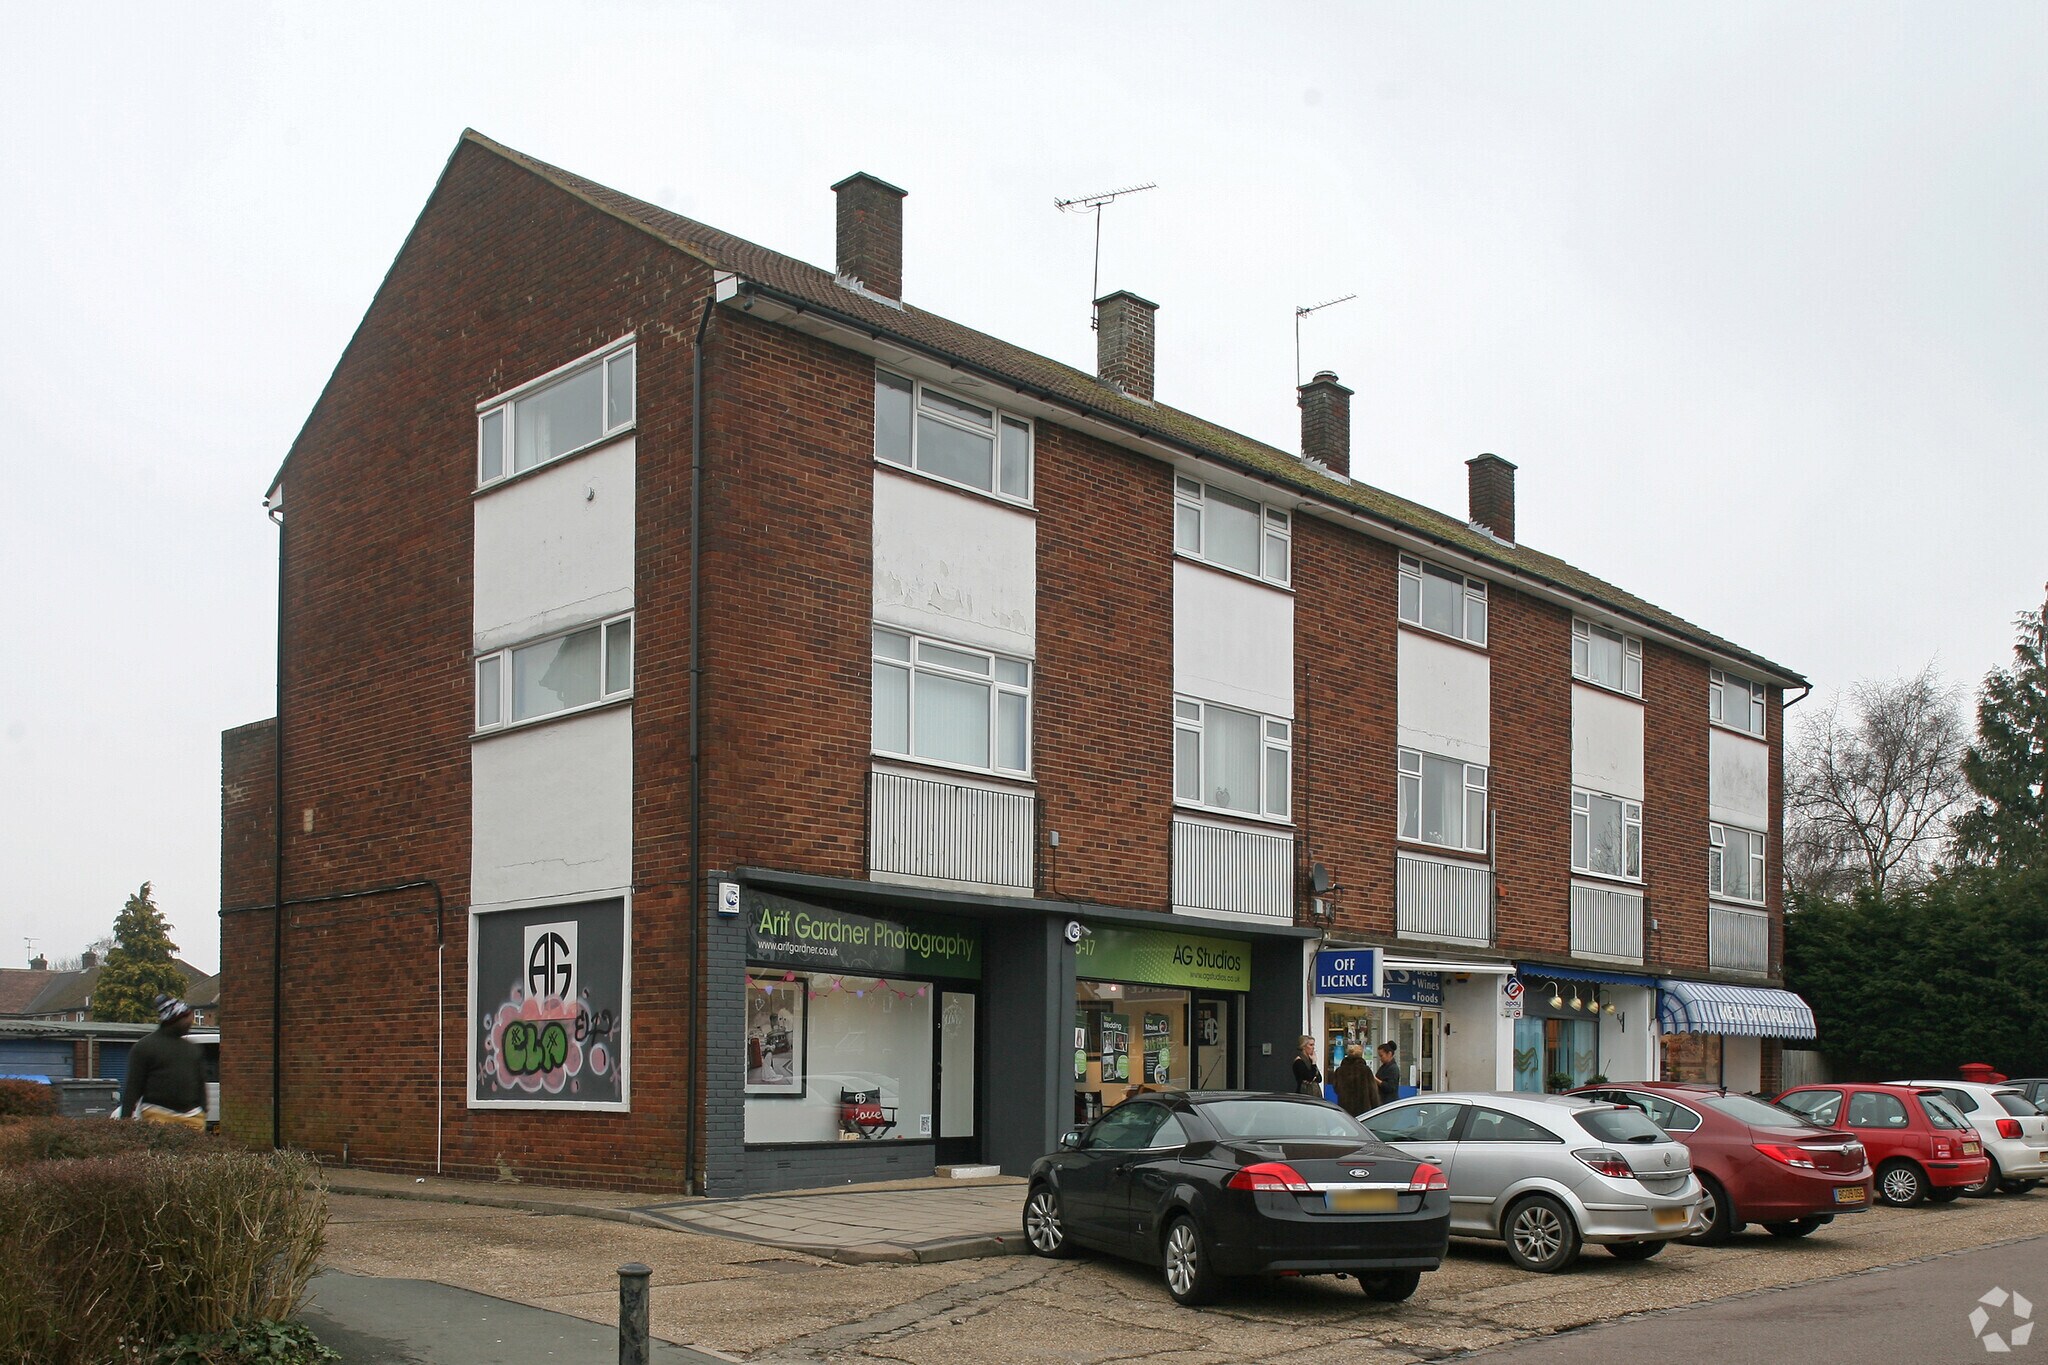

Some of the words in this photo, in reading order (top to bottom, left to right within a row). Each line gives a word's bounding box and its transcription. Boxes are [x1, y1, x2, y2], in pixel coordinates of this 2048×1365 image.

[758, 908, 791, 937] Arif
[794, 912, 870, 945] Gardner
[874, 922, 975, 962] Photography
[757, 941, 839, 957] www.arifgardner.co.uk
[1172, 944, 1193, 966] AG
[1196, 946, 1241, 972] Studios
[1333, 958, 1356, 972] OFF
[1321, 974, 1368, 988] LICENCE
[1417, 978, 1440, 991] Wines
[1416, 991, 1439, 1004] Foods
[1718, 1004, 1745, 1021] MEAT
[1103, 1021, 1122, 1031] Wedding
